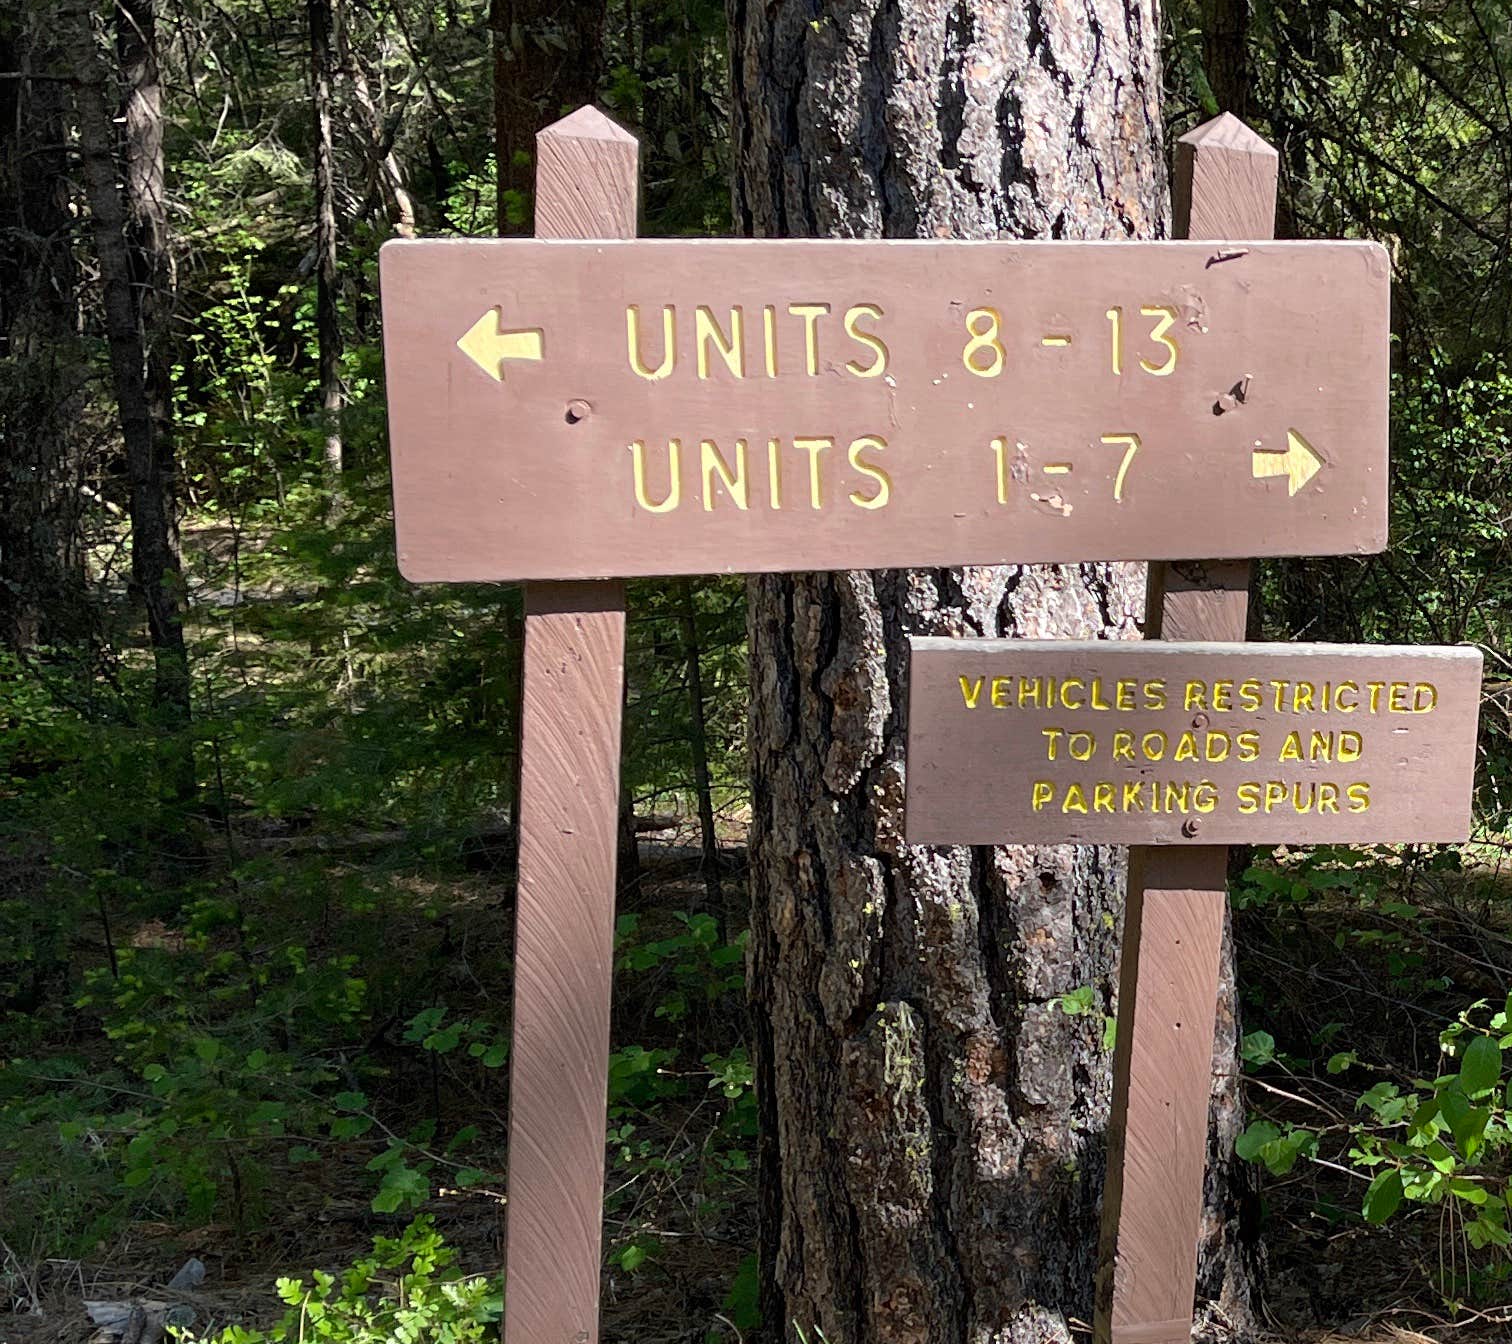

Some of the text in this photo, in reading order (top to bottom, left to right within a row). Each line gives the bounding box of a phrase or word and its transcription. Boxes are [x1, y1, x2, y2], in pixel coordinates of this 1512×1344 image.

[625, 301, 890, 380] UNITS
[961, 306, 1006, 378] 8
[1105, 304, 1180, 377] 13
[630, 434, 892, 514] UNITS
[1099, 432, 1142, 503] 7
[958, 674, 1440, 715] VEHICLES RESTRICTED
[1041, 727, 1364, 764] TO ROADS AND
[1031, 778, 1372, 814] PARKING SPURS
